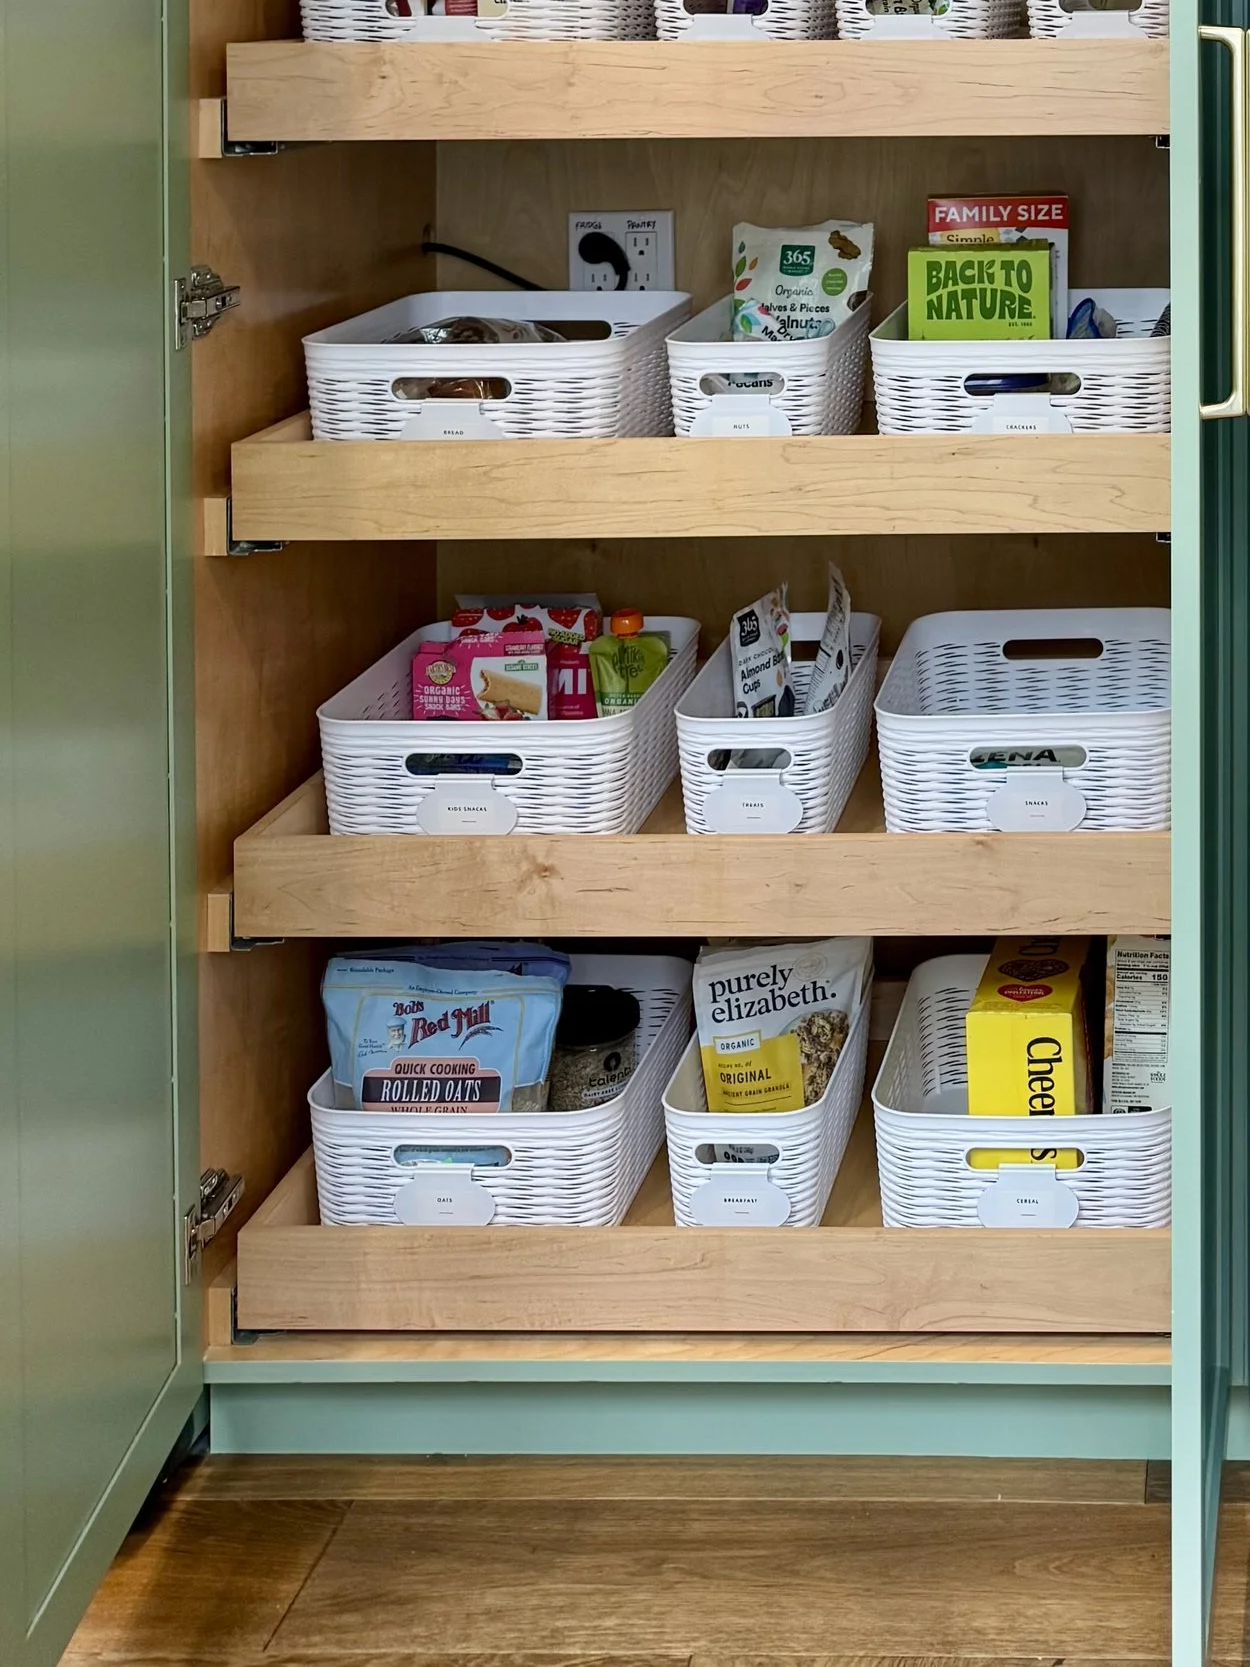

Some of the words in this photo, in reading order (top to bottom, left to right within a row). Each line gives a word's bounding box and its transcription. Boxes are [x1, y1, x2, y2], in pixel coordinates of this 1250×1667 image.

[934, 204, 1012, 223] FAMILY
[1017, 204, 1064, 221] SIZE
[575, 220, 602, 232] FRIDGE
[626, 219, 656, 230] PANTRY
[784, 250, 812, 266] 365
[926, 260, 996, 296] BACK
[1000, 259, 1033, 294] TO
[775, 284, 814, 298] Organic
[790, 302, 798, 312] &
[800, 303, 830, 313] Pieces
[926, 287, 1033, 320] NATURE
[740, 616, 758, 636] 365
[740, 658, 771, 682] Almond
[742, 680, 761, 695] Cups
[708, 964, 794, 1005] purely
[392, 1000, 425, 1016] Bob's
[408, 1010, 450, 1049] Red
[450, 1000, 492, 1039] Mill
[720, 1038, 755, 1050] ORGANIC
[394, 1063, 426, 1076] QUICK
[430, 1063, 476, 1075] COOKING
[720, 1068, 772, 1084] ORIGINAL
[380, 1079, 440, 1102] ROLLED
[444, 1079, 482, 1102] OATS
[744, 1088, 762, 1096] GRAIN
[764, 1083, 790, 1094] GRANOLA
